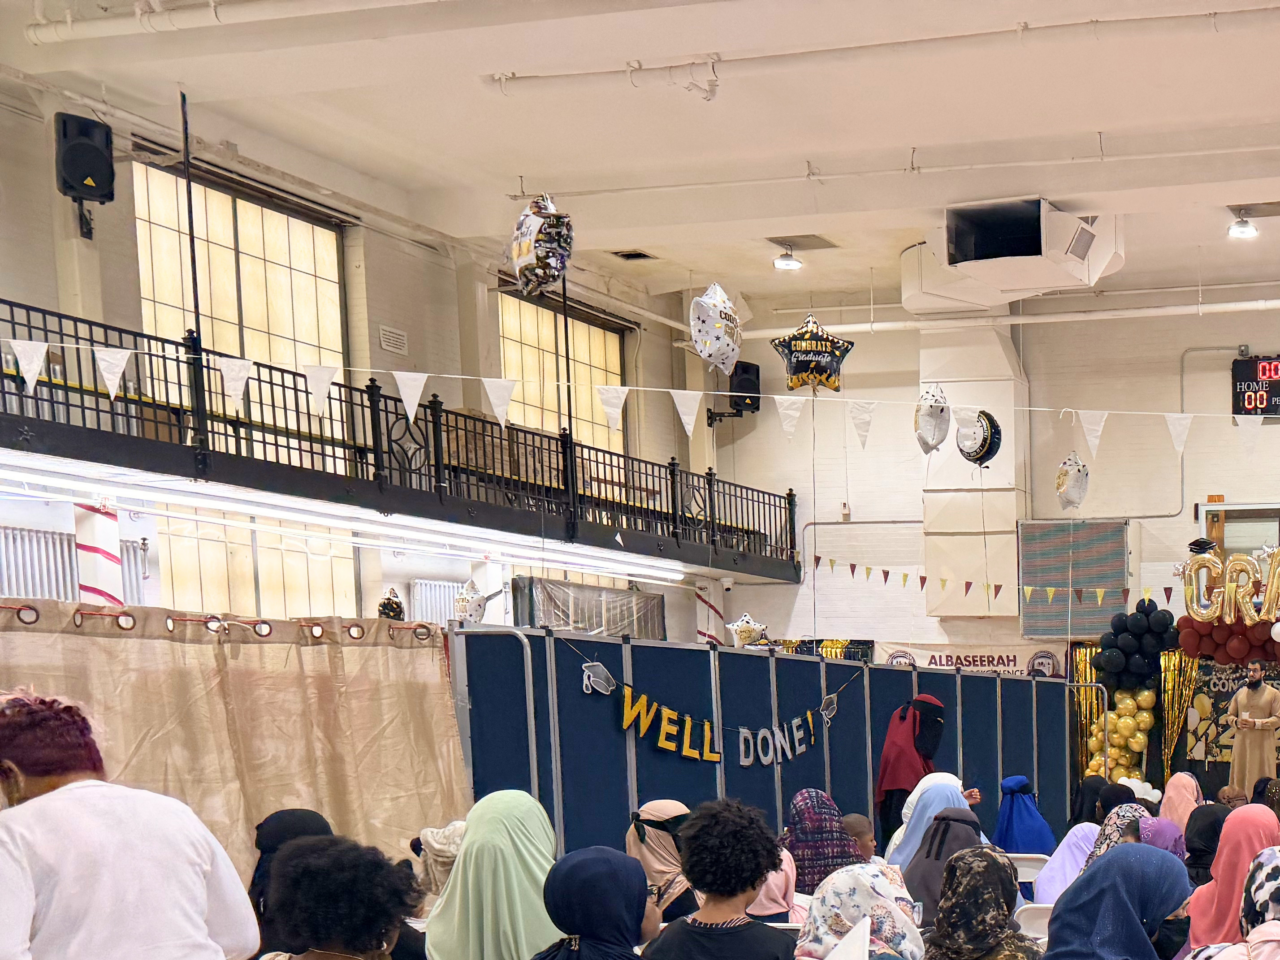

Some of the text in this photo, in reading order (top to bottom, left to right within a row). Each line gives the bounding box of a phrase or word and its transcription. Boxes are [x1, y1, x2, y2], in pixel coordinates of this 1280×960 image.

[791, 340, 832, 352] CONGRATS
[791, 351, 832, 363] Graduate
[1236, 381, 1270, 392] HOME
[1244, 391, 1267, 409] 00
[927, 654, 1017, 668] ALBASEERAH
[622, 684, 815, 768] WELL DONE!
